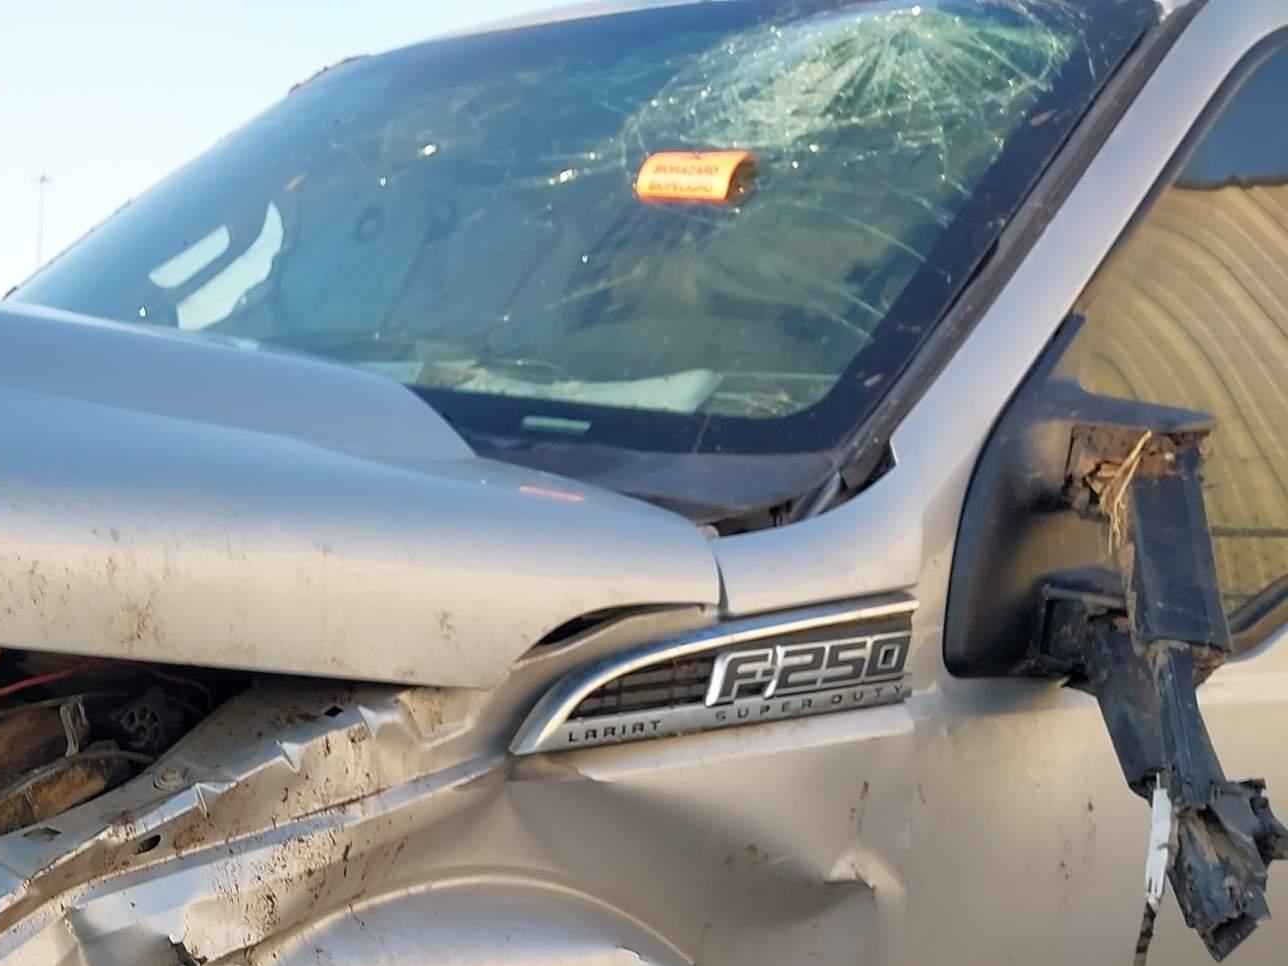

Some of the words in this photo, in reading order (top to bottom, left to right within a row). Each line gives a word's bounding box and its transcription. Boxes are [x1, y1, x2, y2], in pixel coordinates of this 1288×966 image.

[714, 698, 813, 724] SUPER
[829, 684, 904, 706] DUTY
[568, 719, 661, 743] LARIAT
